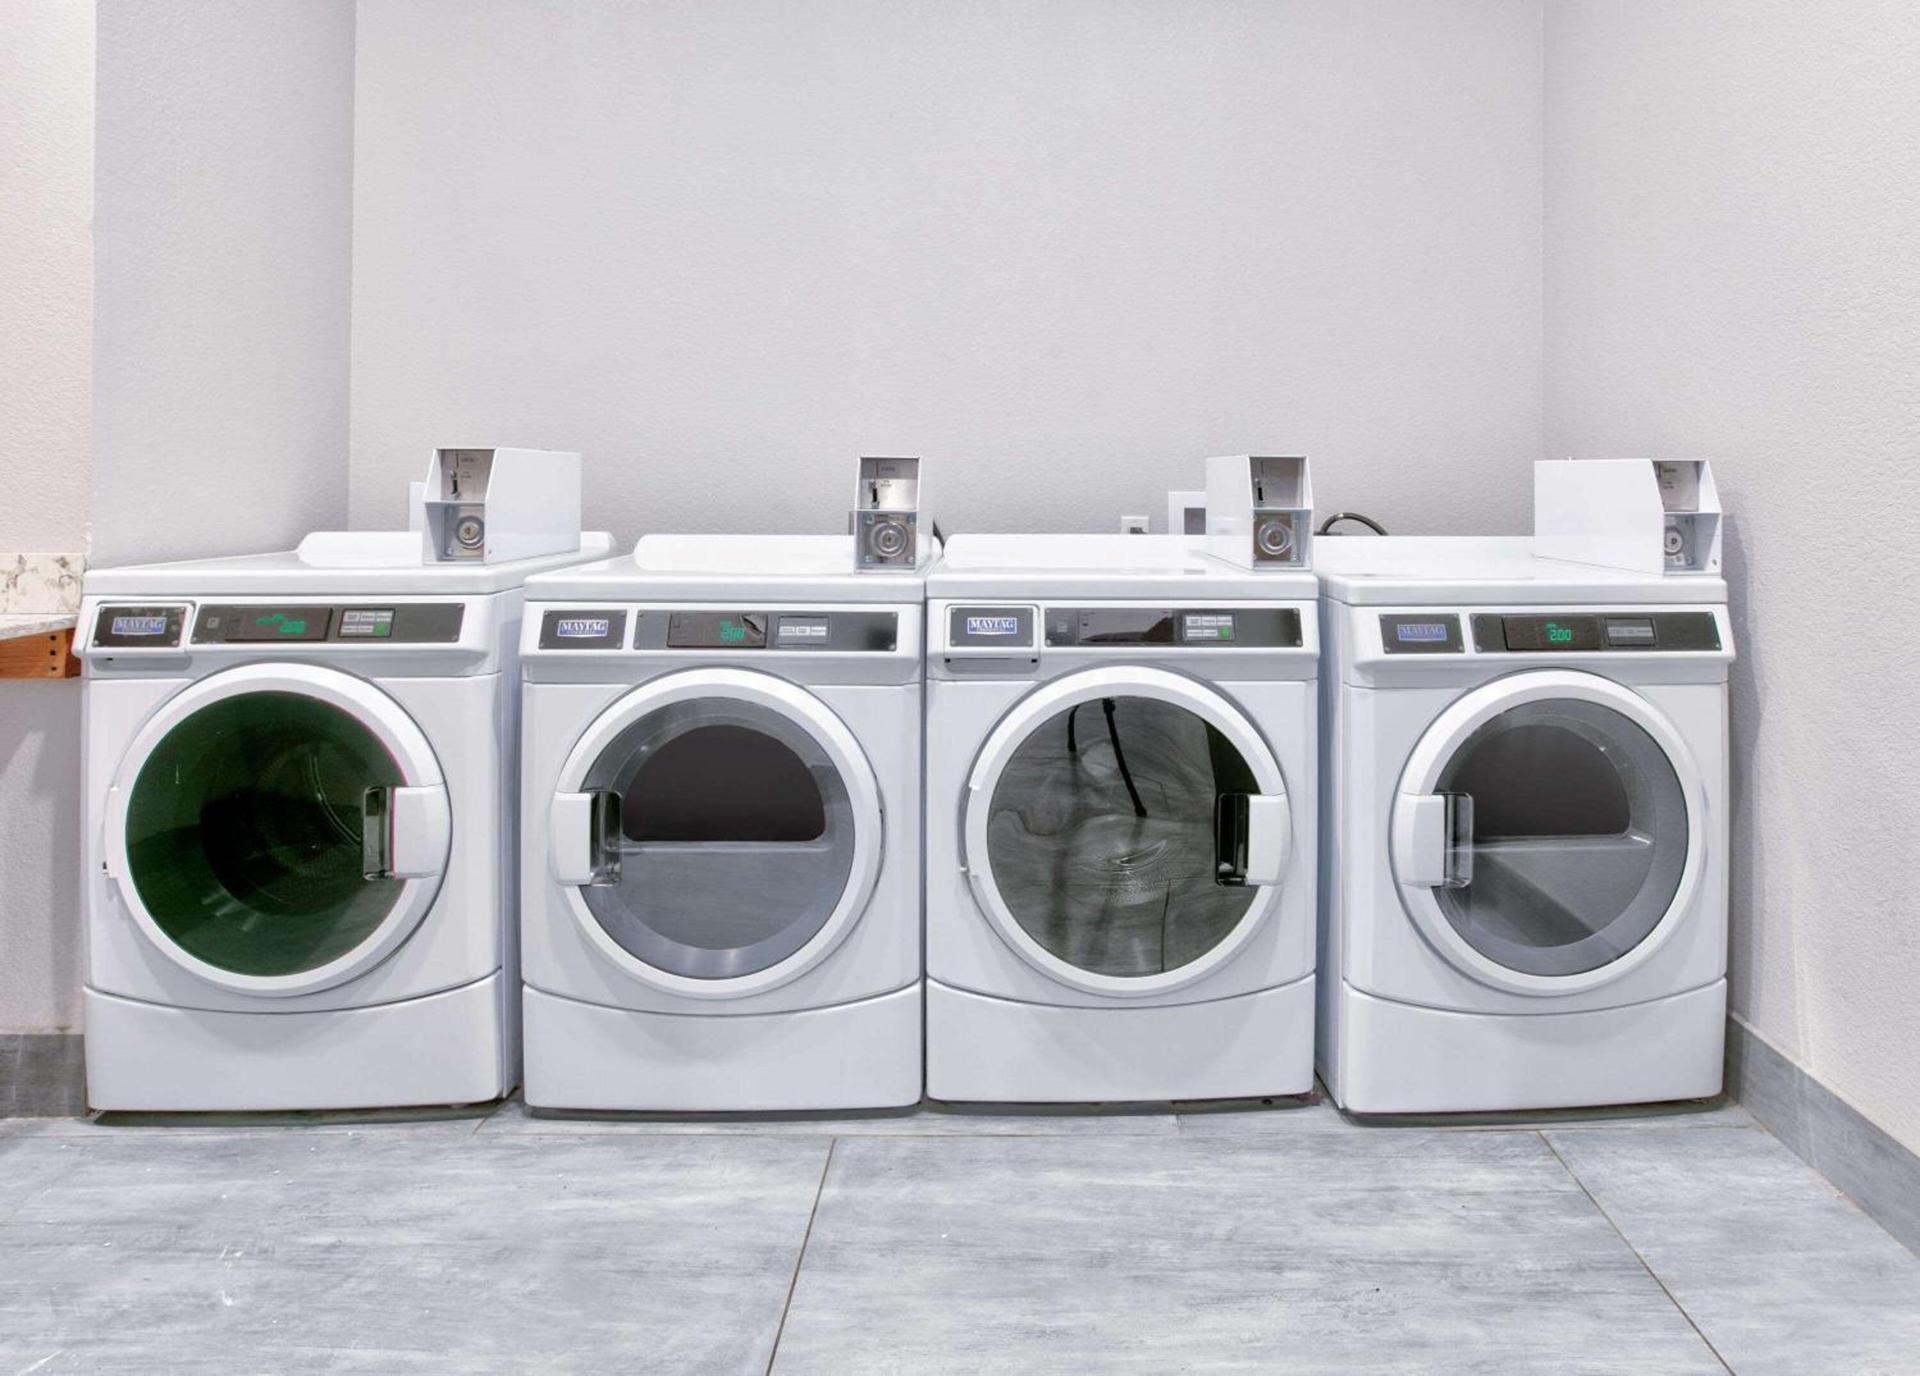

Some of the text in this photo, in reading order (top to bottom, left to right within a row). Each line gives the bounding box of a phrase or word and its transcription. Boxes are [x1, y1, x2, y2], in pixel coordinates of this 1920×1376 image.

[115, 619, 162, 629] MAYTAG
[561, 621, 605, 631] MAYTAG
[970, 619, 1014, 629] MAYTAG
[1401, 625, 1444, 634] MAYTAG
